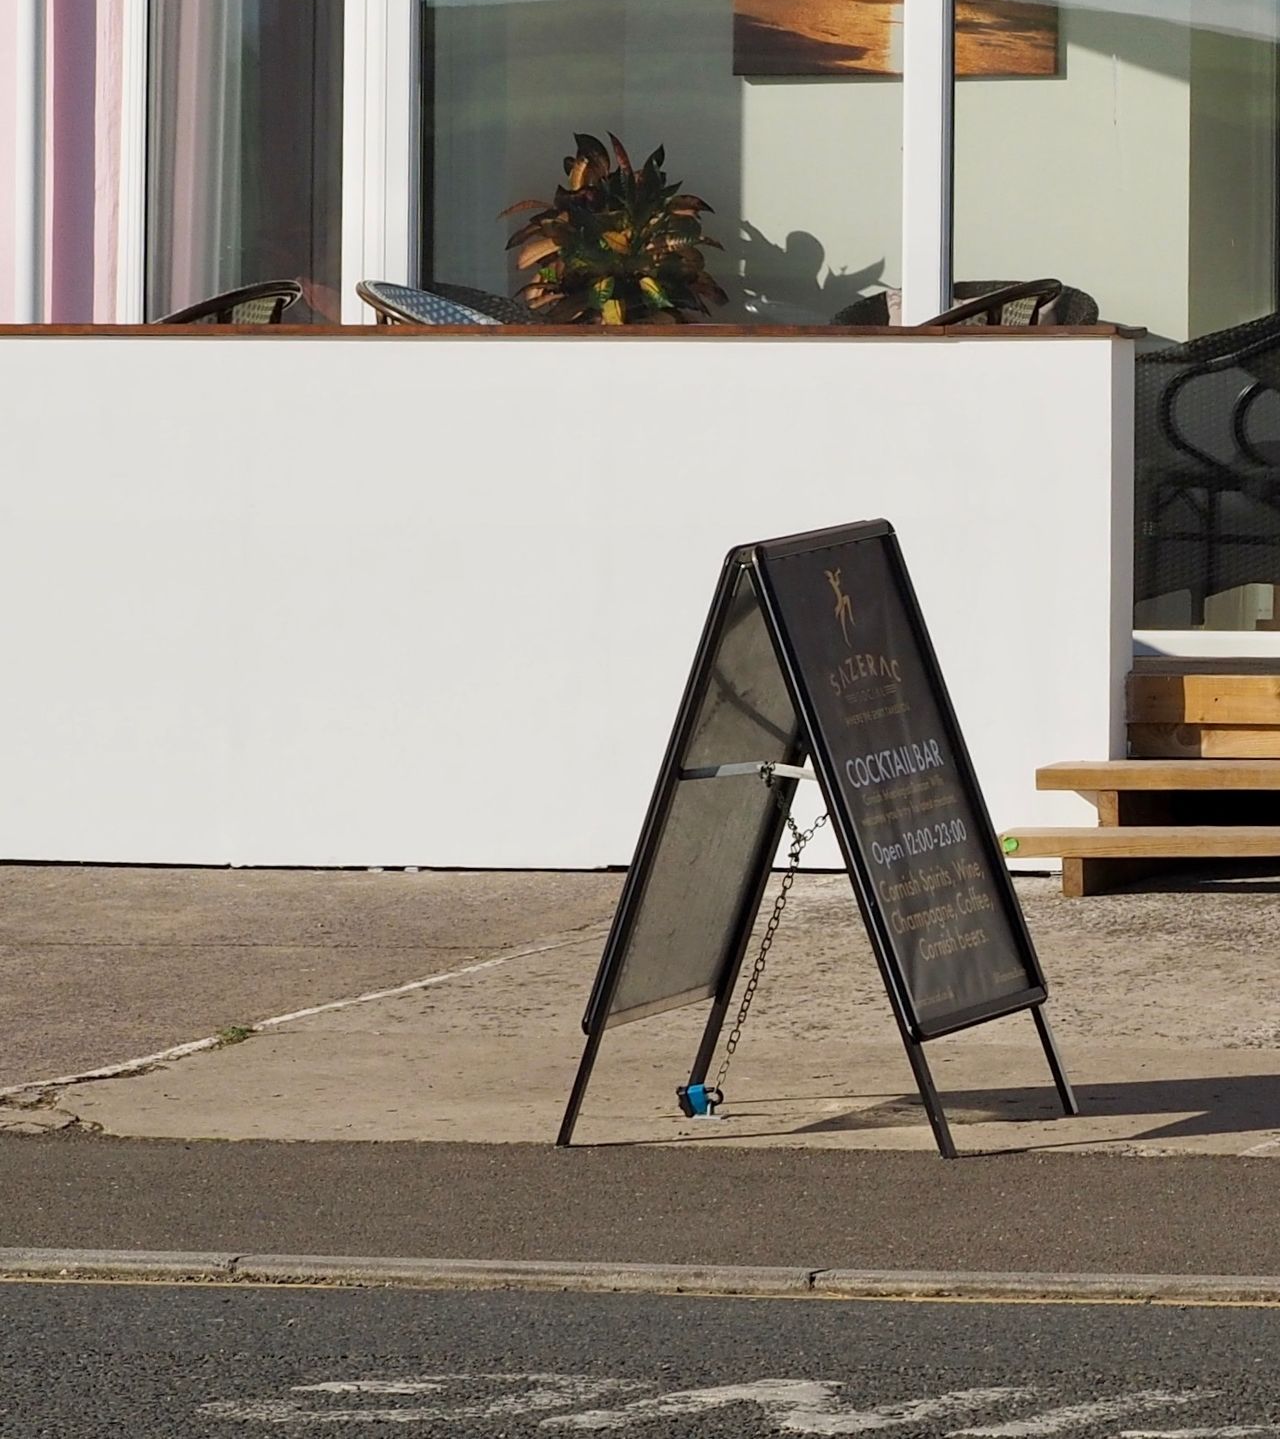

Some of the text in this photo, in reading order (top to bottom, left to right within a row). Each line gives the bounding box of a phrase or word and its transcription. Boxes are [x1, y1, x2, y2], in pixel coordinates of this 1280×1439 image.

[830, 653, 902, 697] SAZERAC
[846, 738, 944, 789] COCKTAIL BAR
[872, 818, 968, 870] Open 12:00-23:00
[879, 870, 921, 903] Cornish
[952, 858, 985, 880] Wine,
[891, 885, 994, 935] Champagne, Coffee,
[919, 929, 958, 962] Cornish
